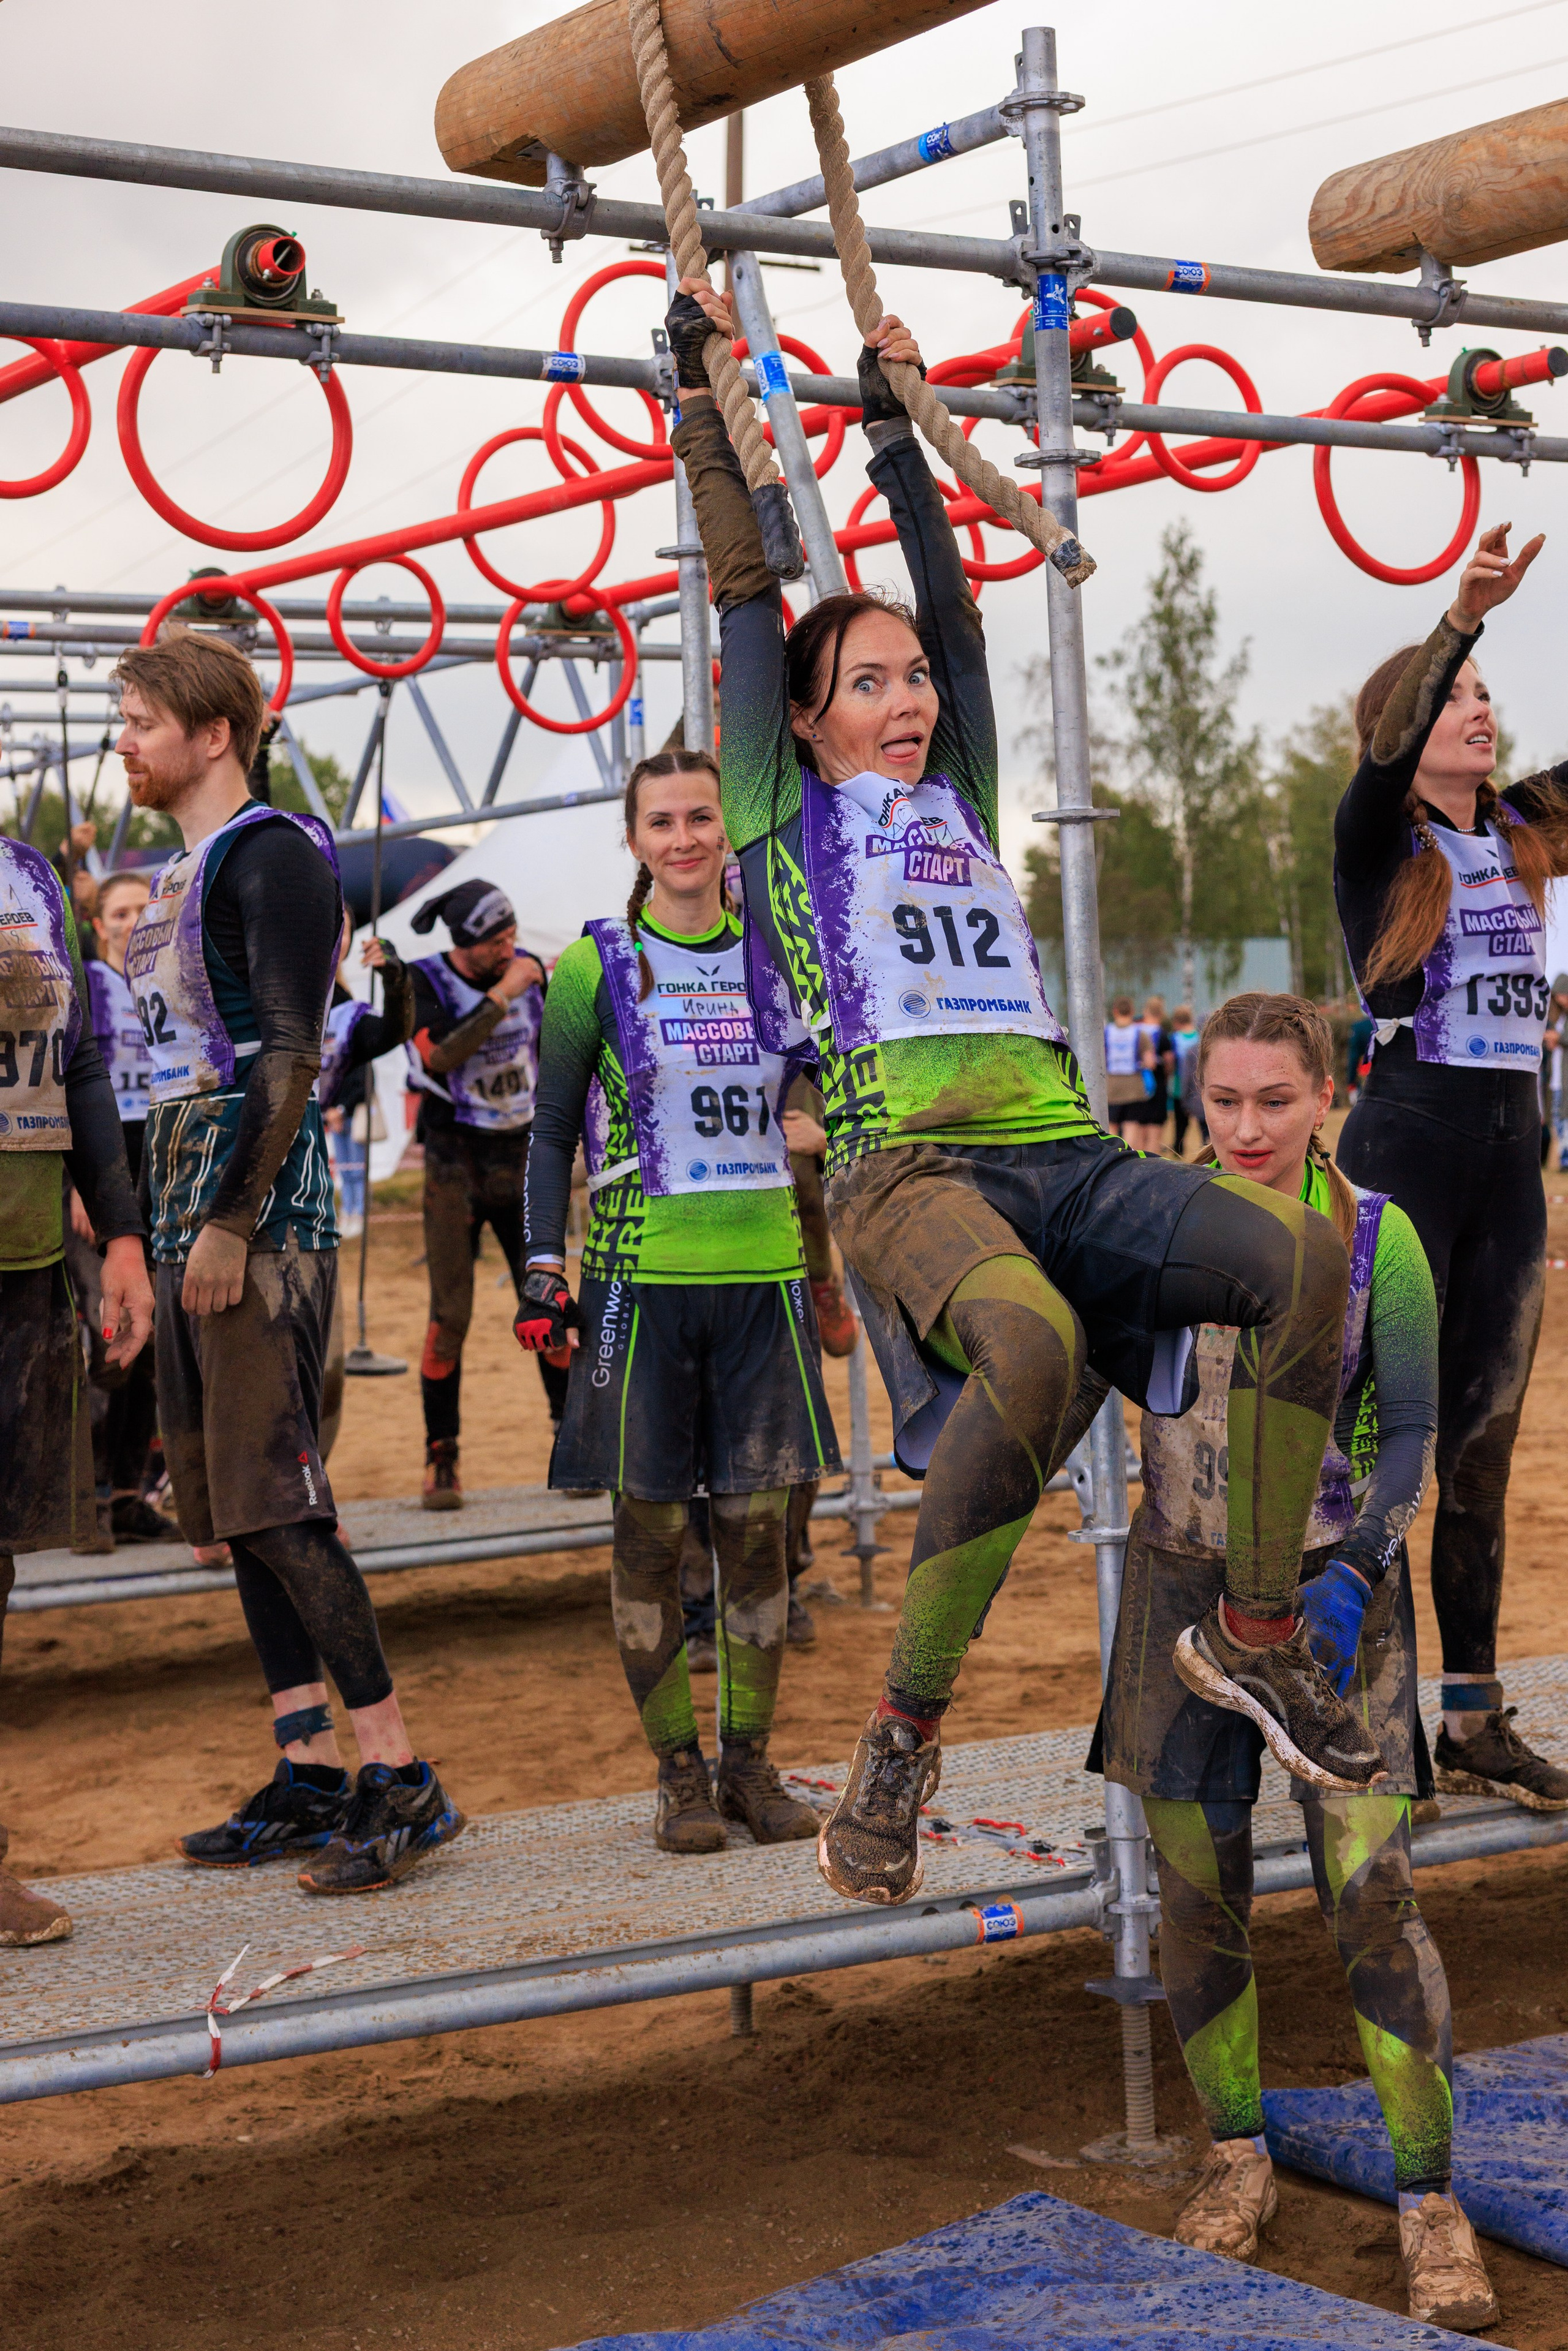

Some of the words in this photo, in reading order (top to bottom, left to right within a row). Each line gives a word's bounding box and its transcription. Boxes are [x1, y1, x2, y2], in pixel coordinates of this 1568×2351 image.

[908, 850, 965, 883] СТАРТ
[892, 904, 1011, 968] 912
[657, 982, 707, 994] ГОНКА
[1466, 973, 1551, 1021] 1393
[683, 998, 739, 1017] ИРИНА
[936, 997, 1032, 1014] ГАЗПРОМБАНК
[698, 1043, 754, 1063] СТАРТ
[690, 1085, 770, 1138] 961
[716, 1162, 778, 1175] ГАЗПРОМБАНК
[617, 1292, 631, 1351] GLOBAL
[301, 1464, 318, 1506] Reebok
